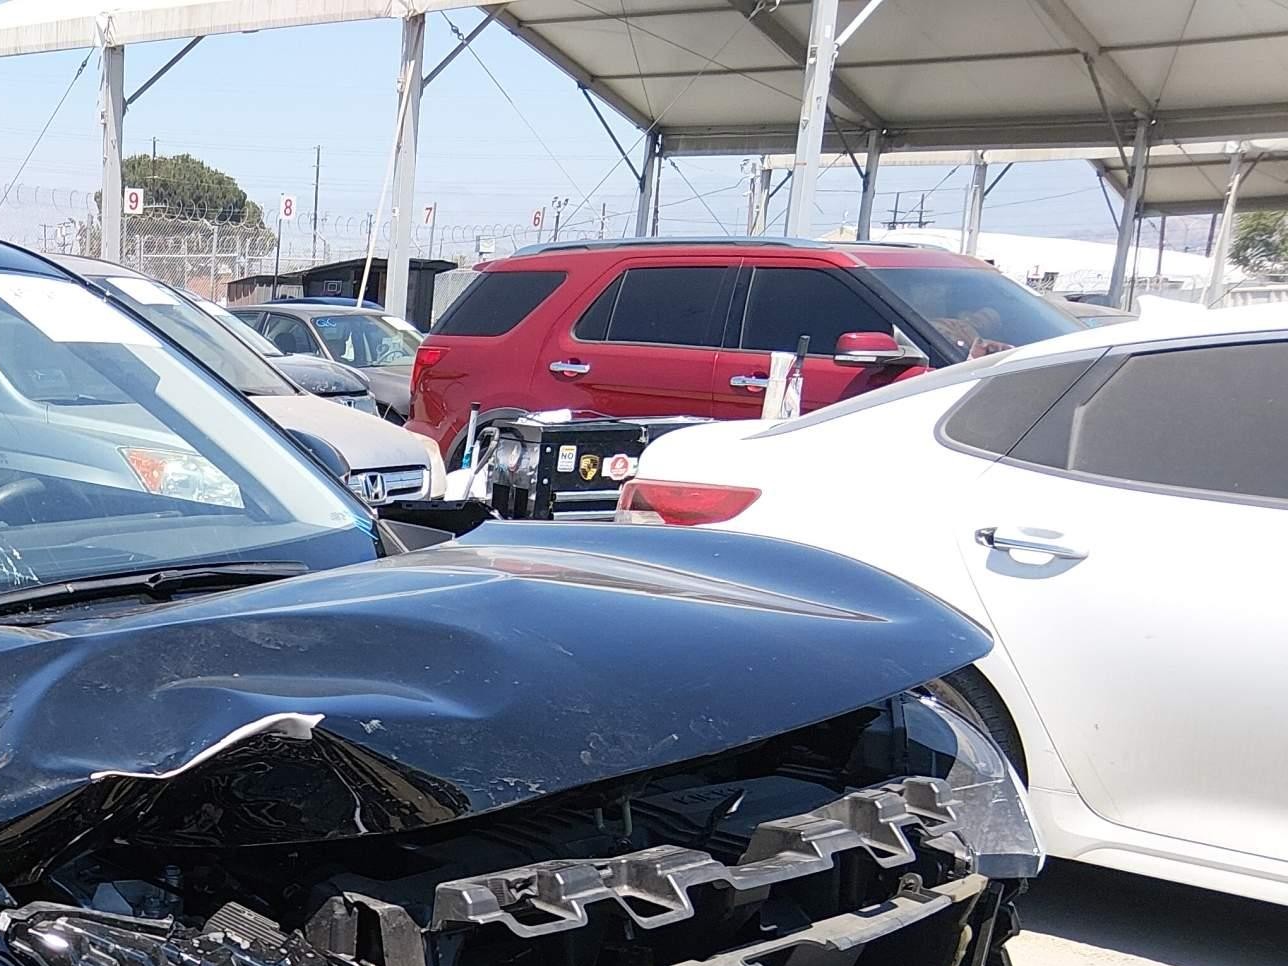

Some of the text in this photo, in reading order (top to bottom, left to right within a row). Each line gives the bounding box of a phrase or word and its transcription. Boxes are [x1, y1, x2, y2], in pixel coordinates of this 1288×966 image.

[129, 191, 139, 210] 9
[283, 198, 292, 216] 8
[424, 206, 433, 224] 7
[533, 210, 541, 227] 6
